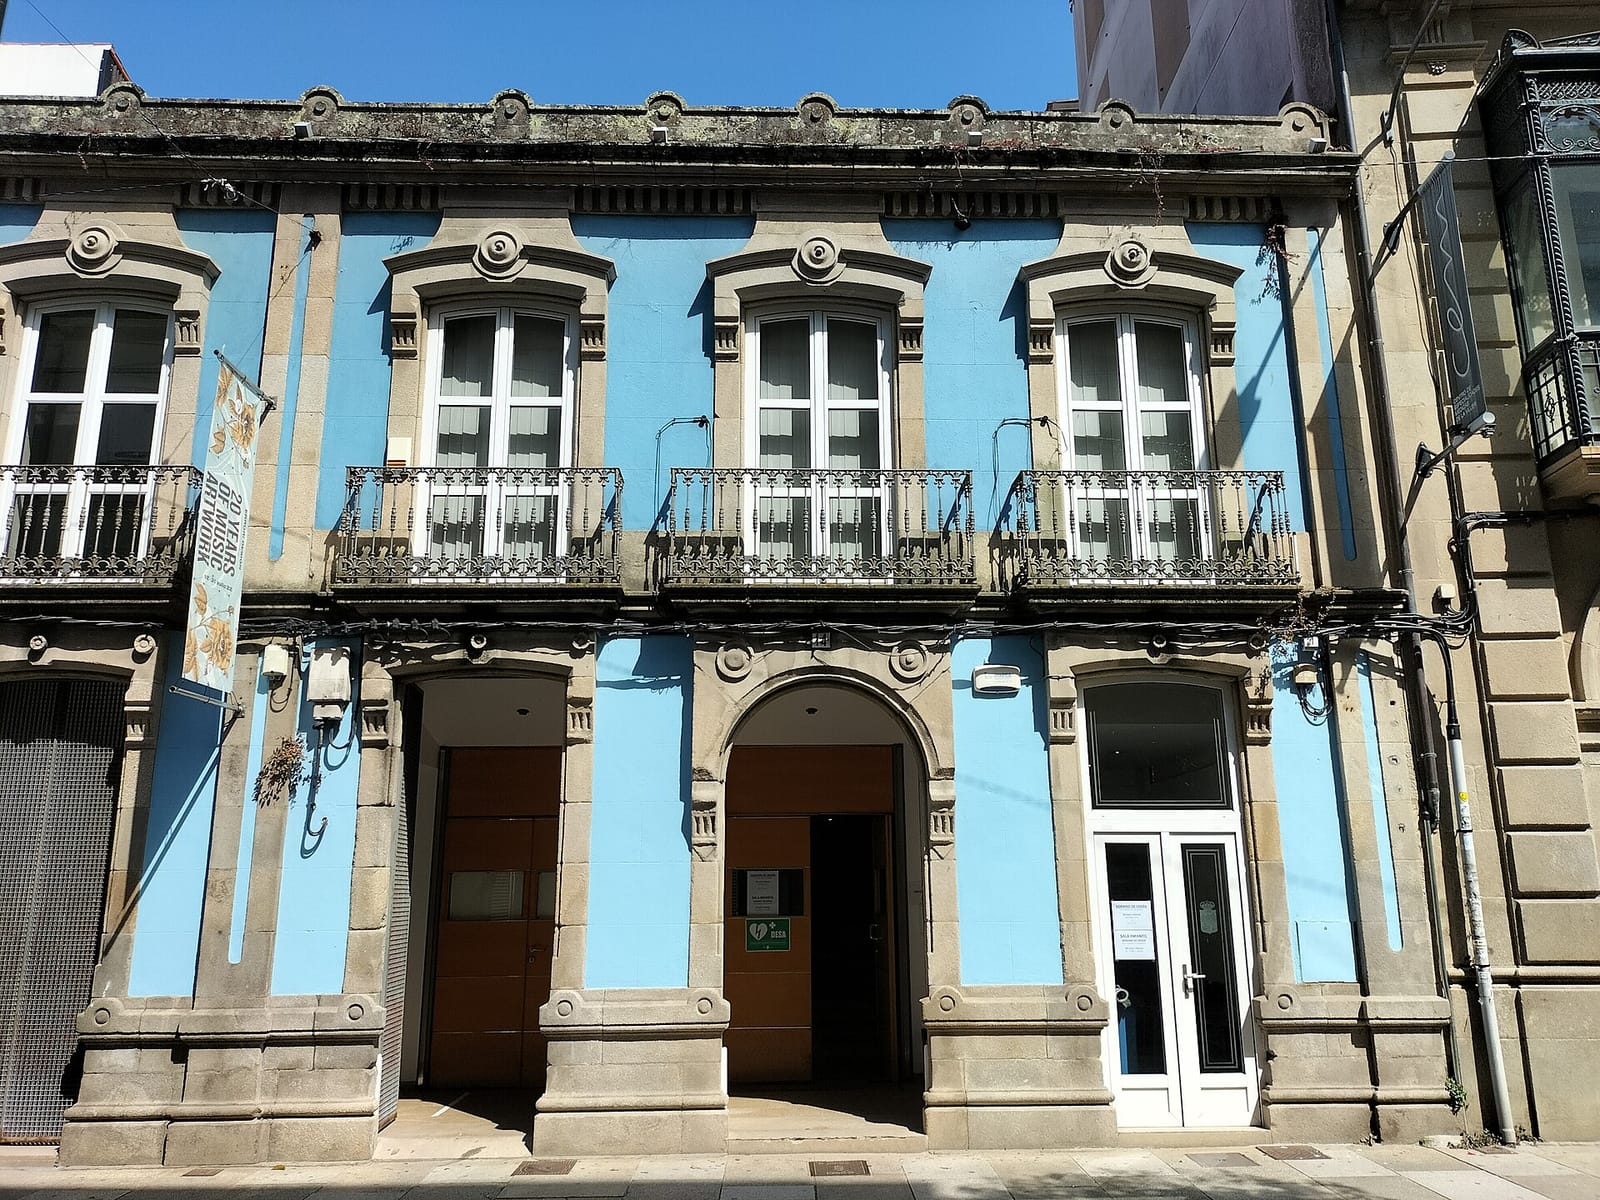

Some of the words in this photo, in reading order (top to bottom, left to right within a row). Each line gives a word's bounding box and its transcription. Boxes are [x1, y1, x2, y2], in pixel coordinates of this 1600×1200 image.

[218, 481, 231, 510] OF
[230, 489, 242, 516] 20
[197, 470, 219, 567] ARTWORK
[210, 508, 228, 572] MUSIC
[223, 517, 240, 577] YEARS
[770, 930, 787, 939] DESA
